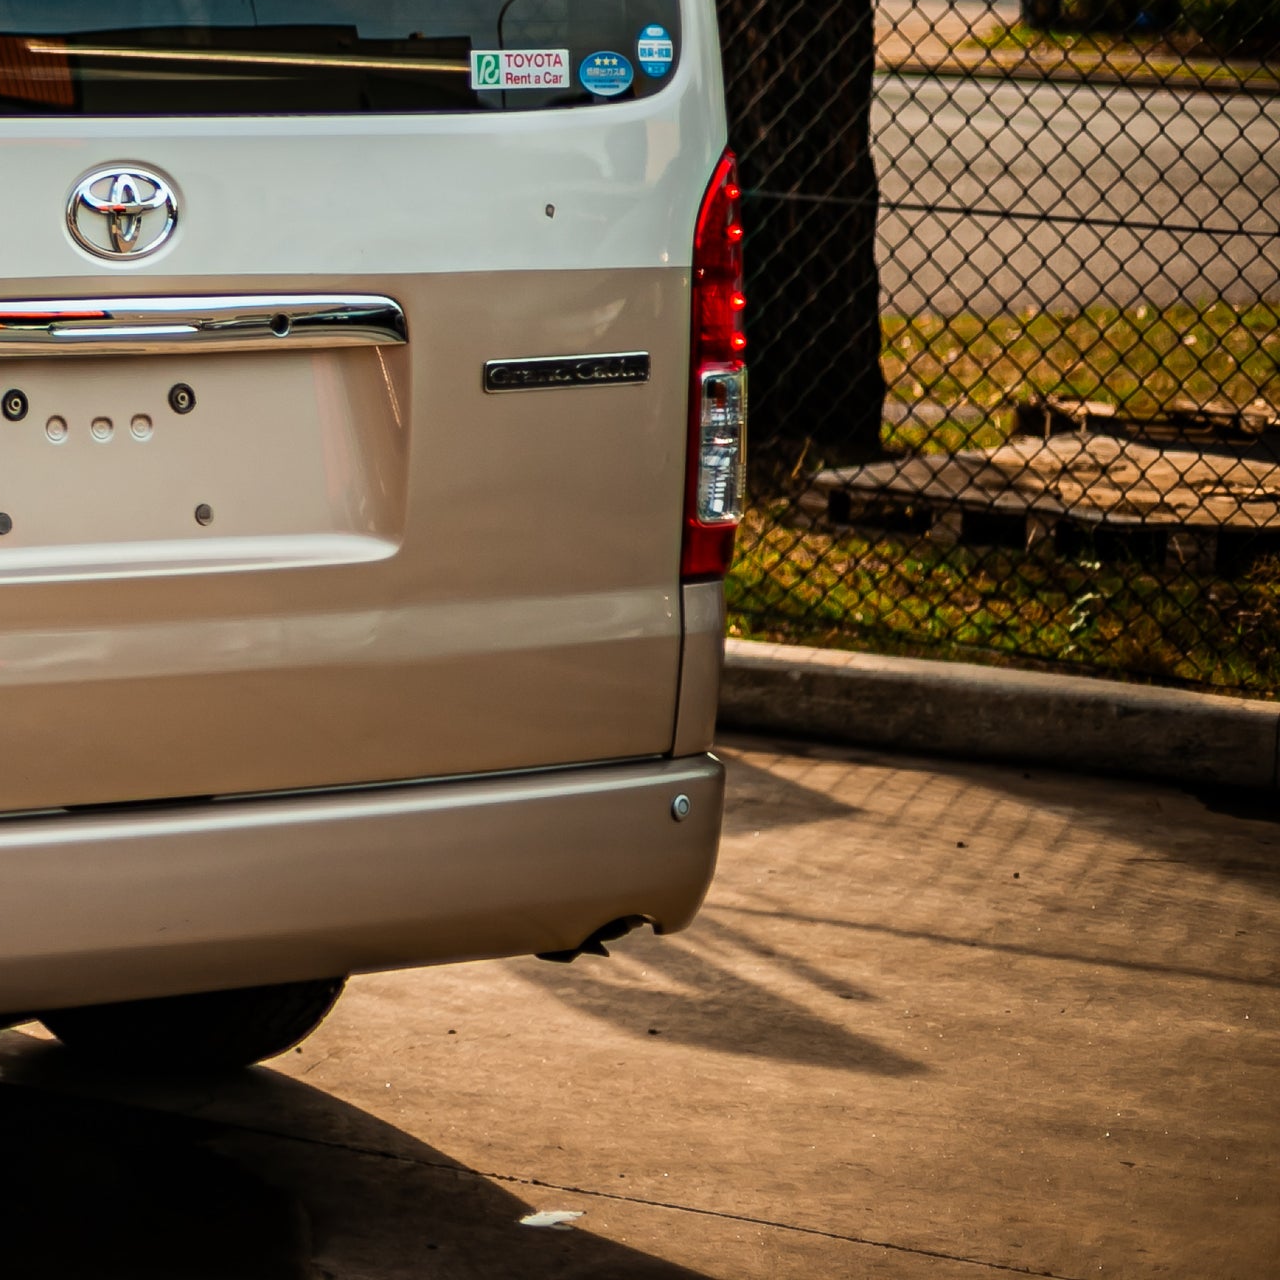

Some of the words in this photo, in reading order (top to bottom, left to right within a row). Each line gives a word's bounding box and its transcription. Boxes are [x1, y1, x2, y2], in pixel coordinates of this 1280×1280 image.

[504, 53, 563, 68] TOYOTA
[505, 72, 531, 85] Rent
[534, 74, 541, 85] a
[543, 71, 563, 85] Car
